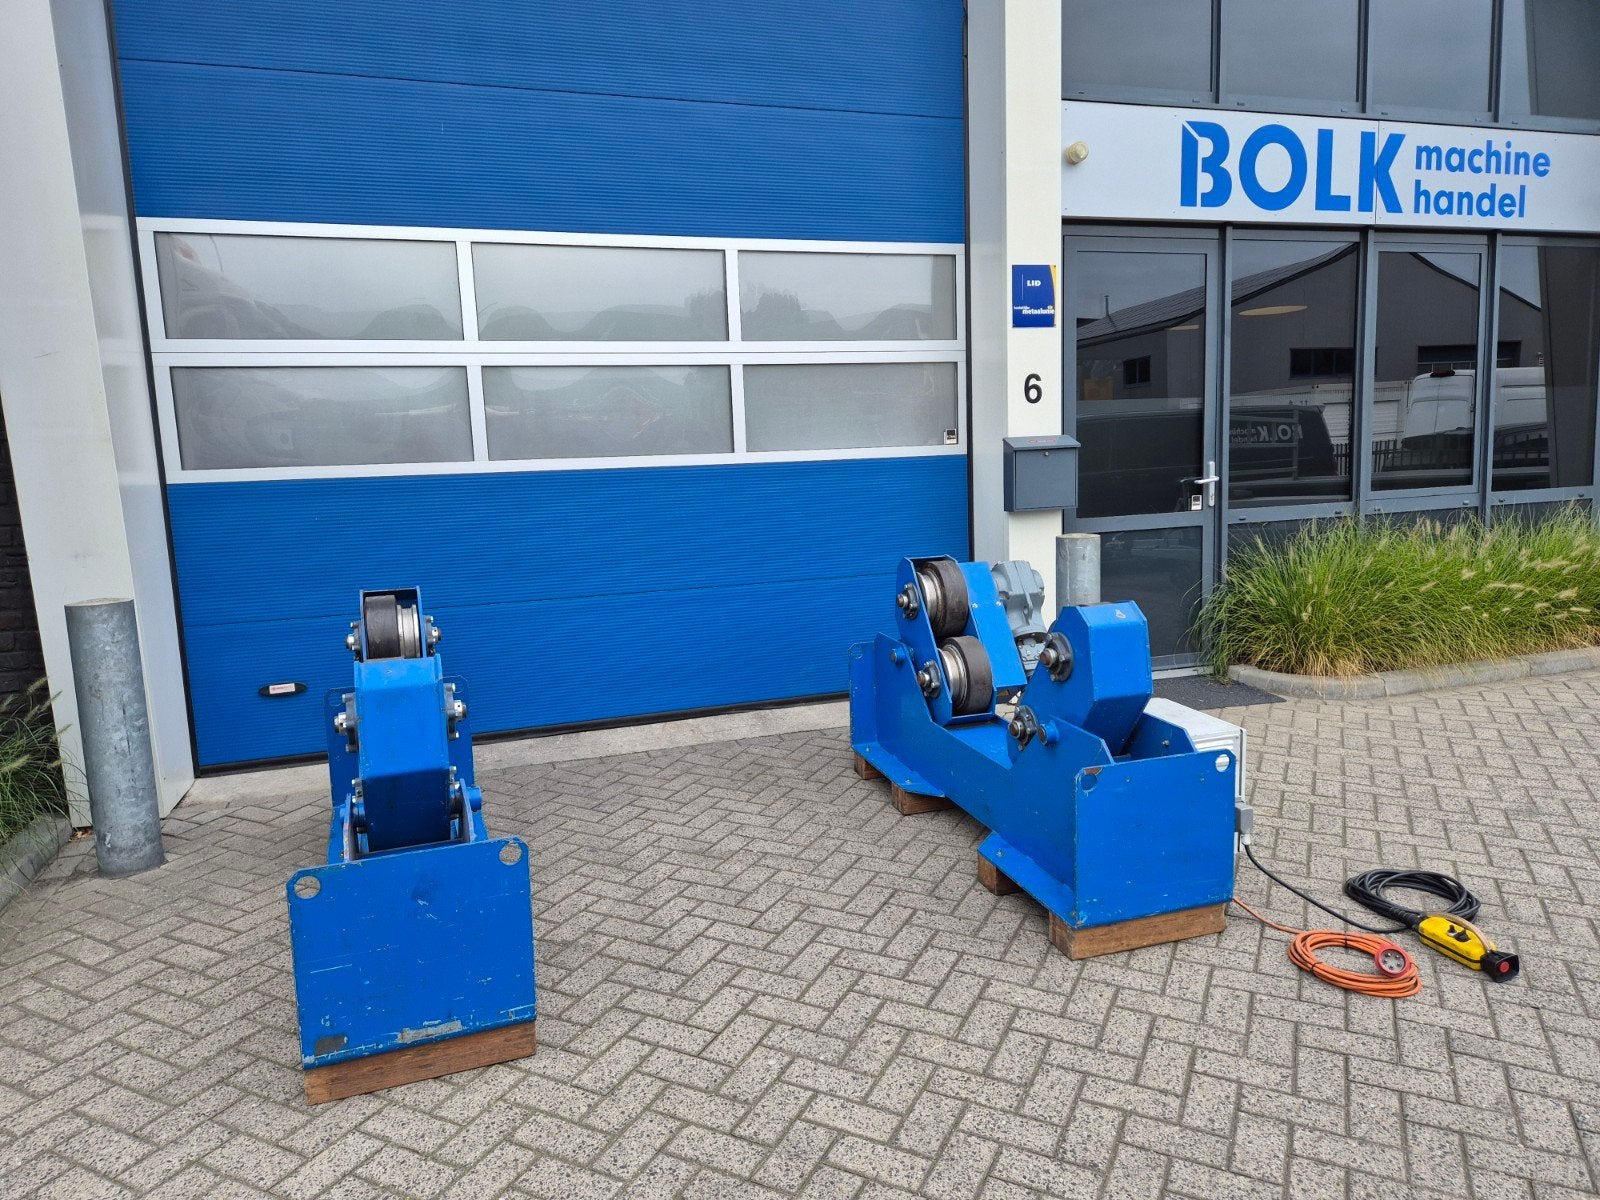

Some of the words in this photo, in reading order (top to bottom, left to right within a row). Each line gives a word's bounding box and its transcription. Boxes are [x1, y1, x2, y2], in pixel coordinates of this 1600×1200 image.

[1180, 120, 1406, 214] BOLK
[1415, 139, 1551, 178] machine
[1413, 179, 1526, 218] handel
[1026, 279, 1042, 287] LID
[1024, 373, 1043, 404] 6
